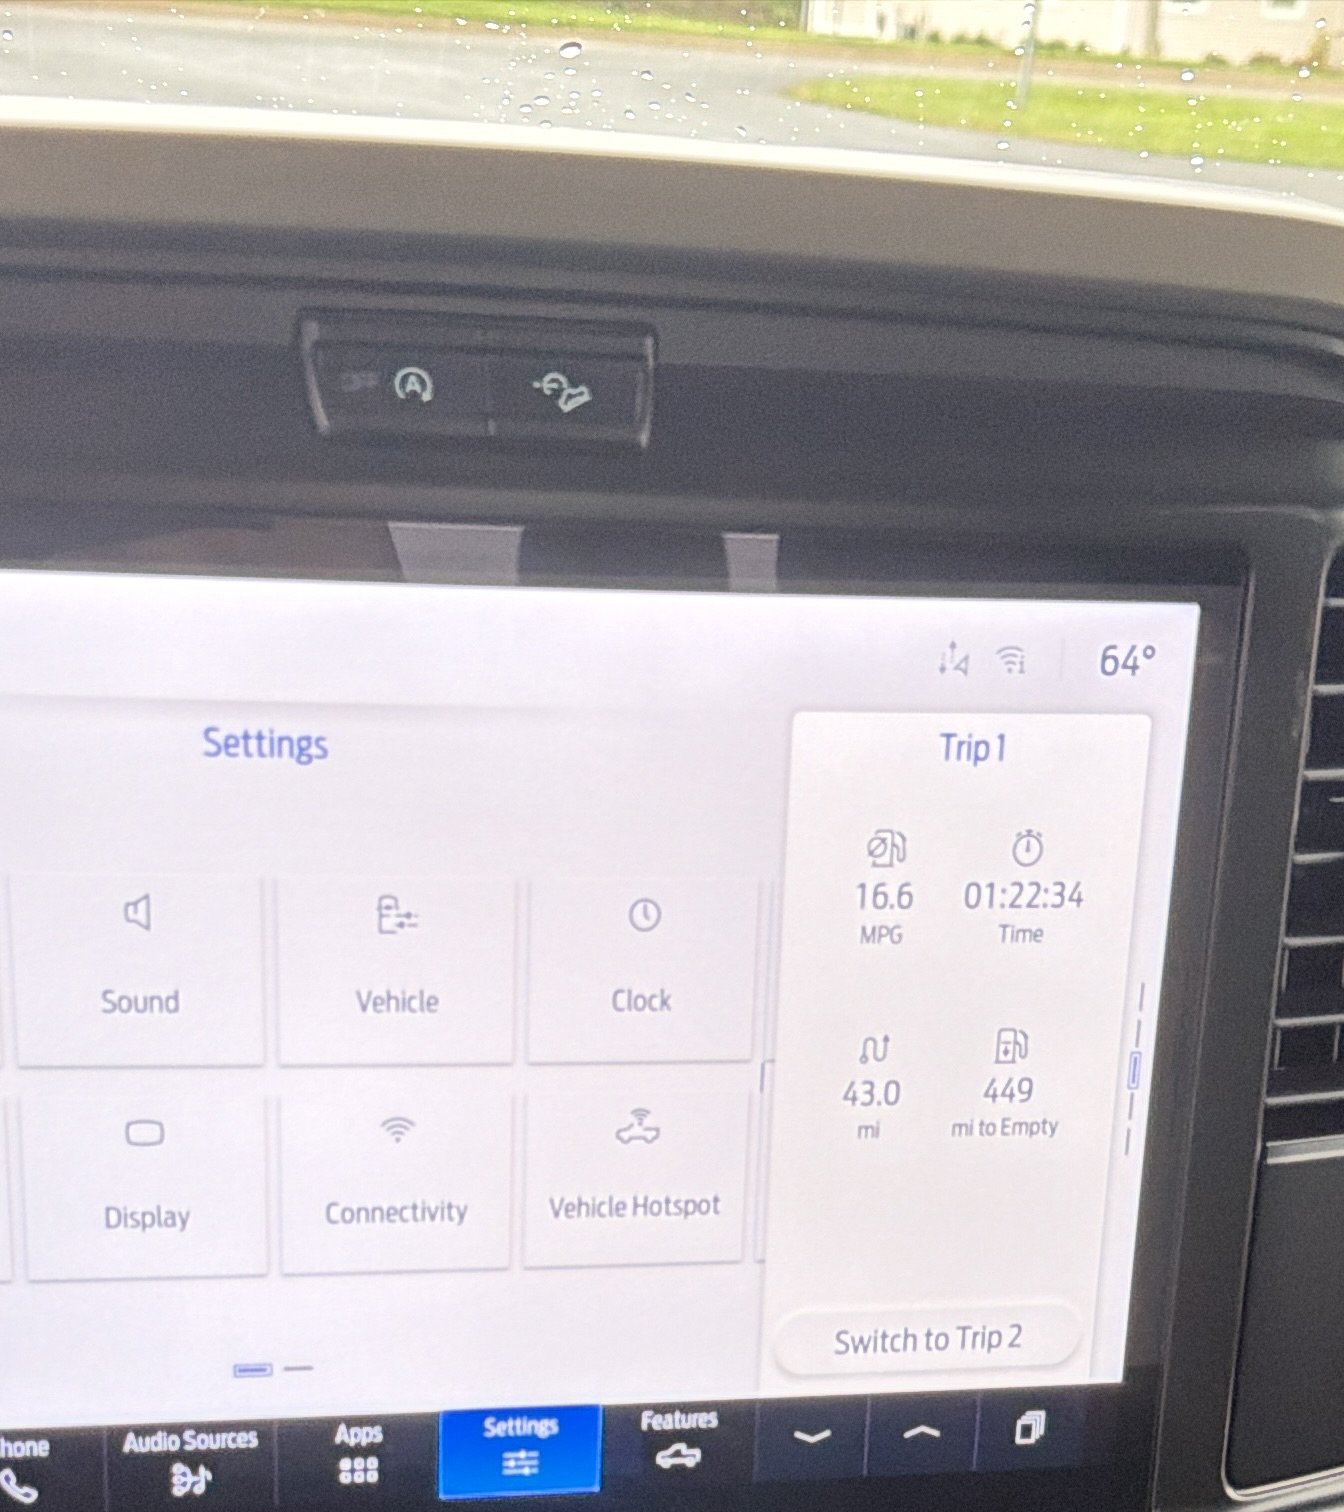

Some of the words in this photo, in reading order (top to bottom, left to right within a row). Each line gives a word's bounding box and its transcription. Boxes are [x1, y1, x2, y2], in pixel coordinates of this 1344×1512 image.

[1098, 643, 1157, 677] 64°
[203, 726, 329, 765] Settings
[940, 732, 990, 767] Trip
[997, 733, 1006, 762] 1
[856, 882, 914, 911] 16.6
[963, 881, 1084, 911] 01:22:34
[860, 924, 903, 945] MPG
[999, 923, 1044, 944] Time
[101, 988, 180, 1014] Sound
[356, 988, 439, 1014] Vehicle
[611, 988, 672, 1013] Clock
[842, 1079, 902, 1107] 43.0
[983, 1075, 1034, 1103] 449
[857, 1121, 880, 1139] mi
[951, 1118, 974, 1138] mi
[978, 1118, 997, 1137] to
[1001, 1115, 1059, 1140] Empty
[104, 1204, 191, 1232] Display
[325, 1199, 468, 1227] Connectivity
[549, 1195, 627, 1220] Vehicle
[632, 1193, 720, 1221] Hotspot
[834, 1328, 919, 1355] Switch
[925, 1328, 949, 1353] to
[956, 1326, 1004, 1356] Trip
[1008, 1324, 1023, 1349] 2
[335, 1422, 384, 1447] Apps
[483, 1415, 559, 1441] Settings
[641, 1409, 718, 1434] Features
[123, 1429, 180, 1454] Audio
[183, 1427, 258, 1451] Sources
